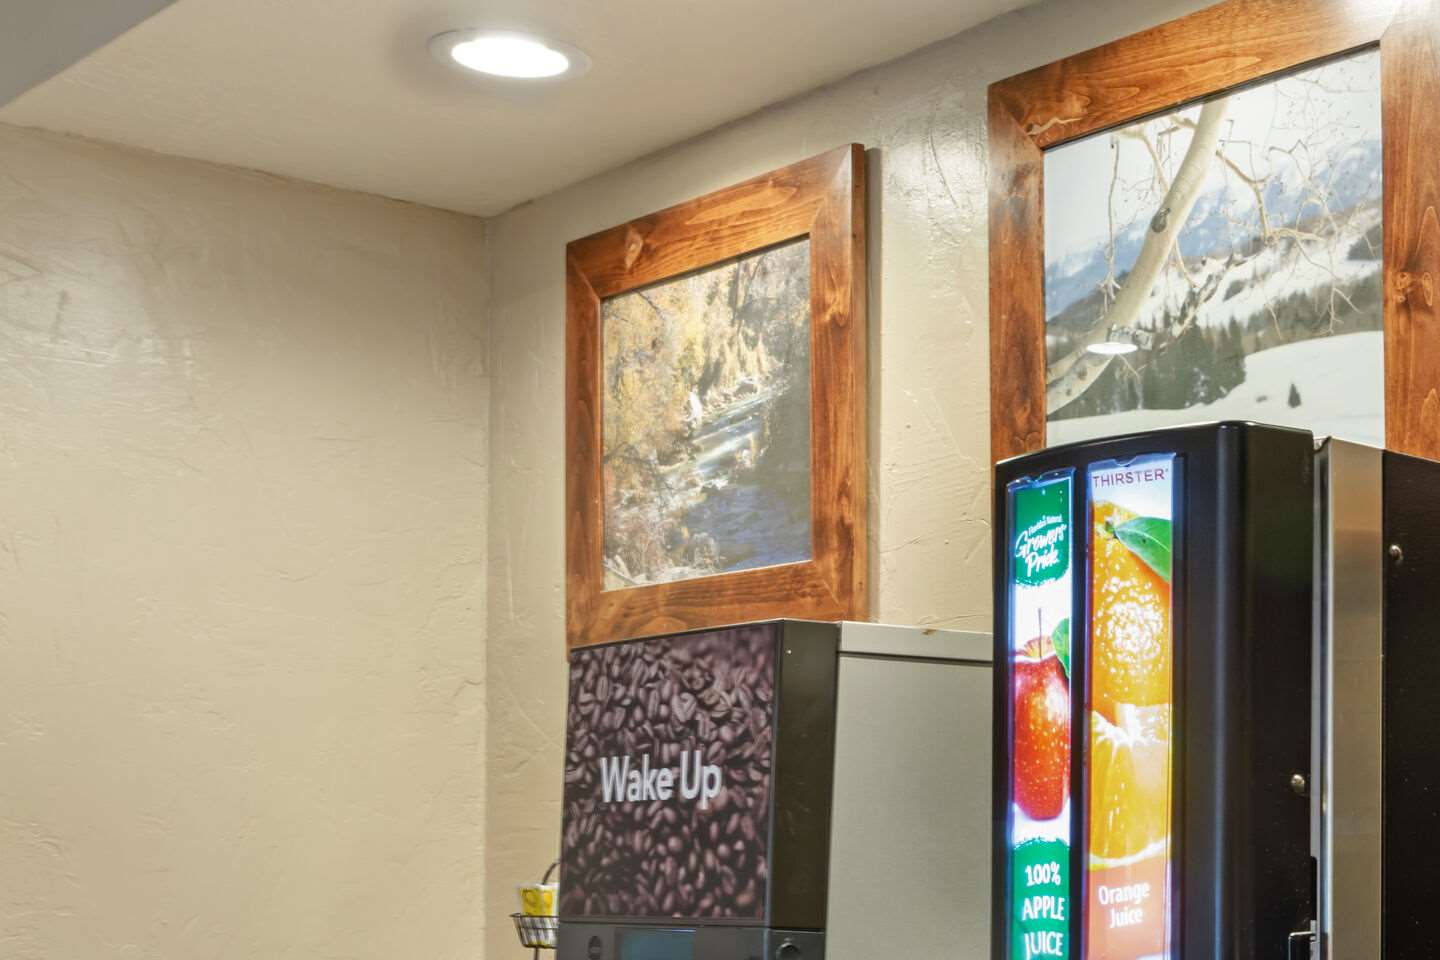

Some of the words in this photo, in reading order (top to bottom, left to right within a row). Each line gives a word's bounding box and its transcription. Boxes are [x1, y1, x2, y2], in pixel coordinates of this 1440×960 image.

[1093, 469, 1165, 488] THIRSTER
[601, 753, 673, 804] Wake
[680, 750, 722, 810] Up
[1024, 860, 1062, 887] 100%
[1098, 881, 1150, 905] Orange
[1022, 895, 1065, 922] APPLE
[1109, 906, 1143, 929] Juice
